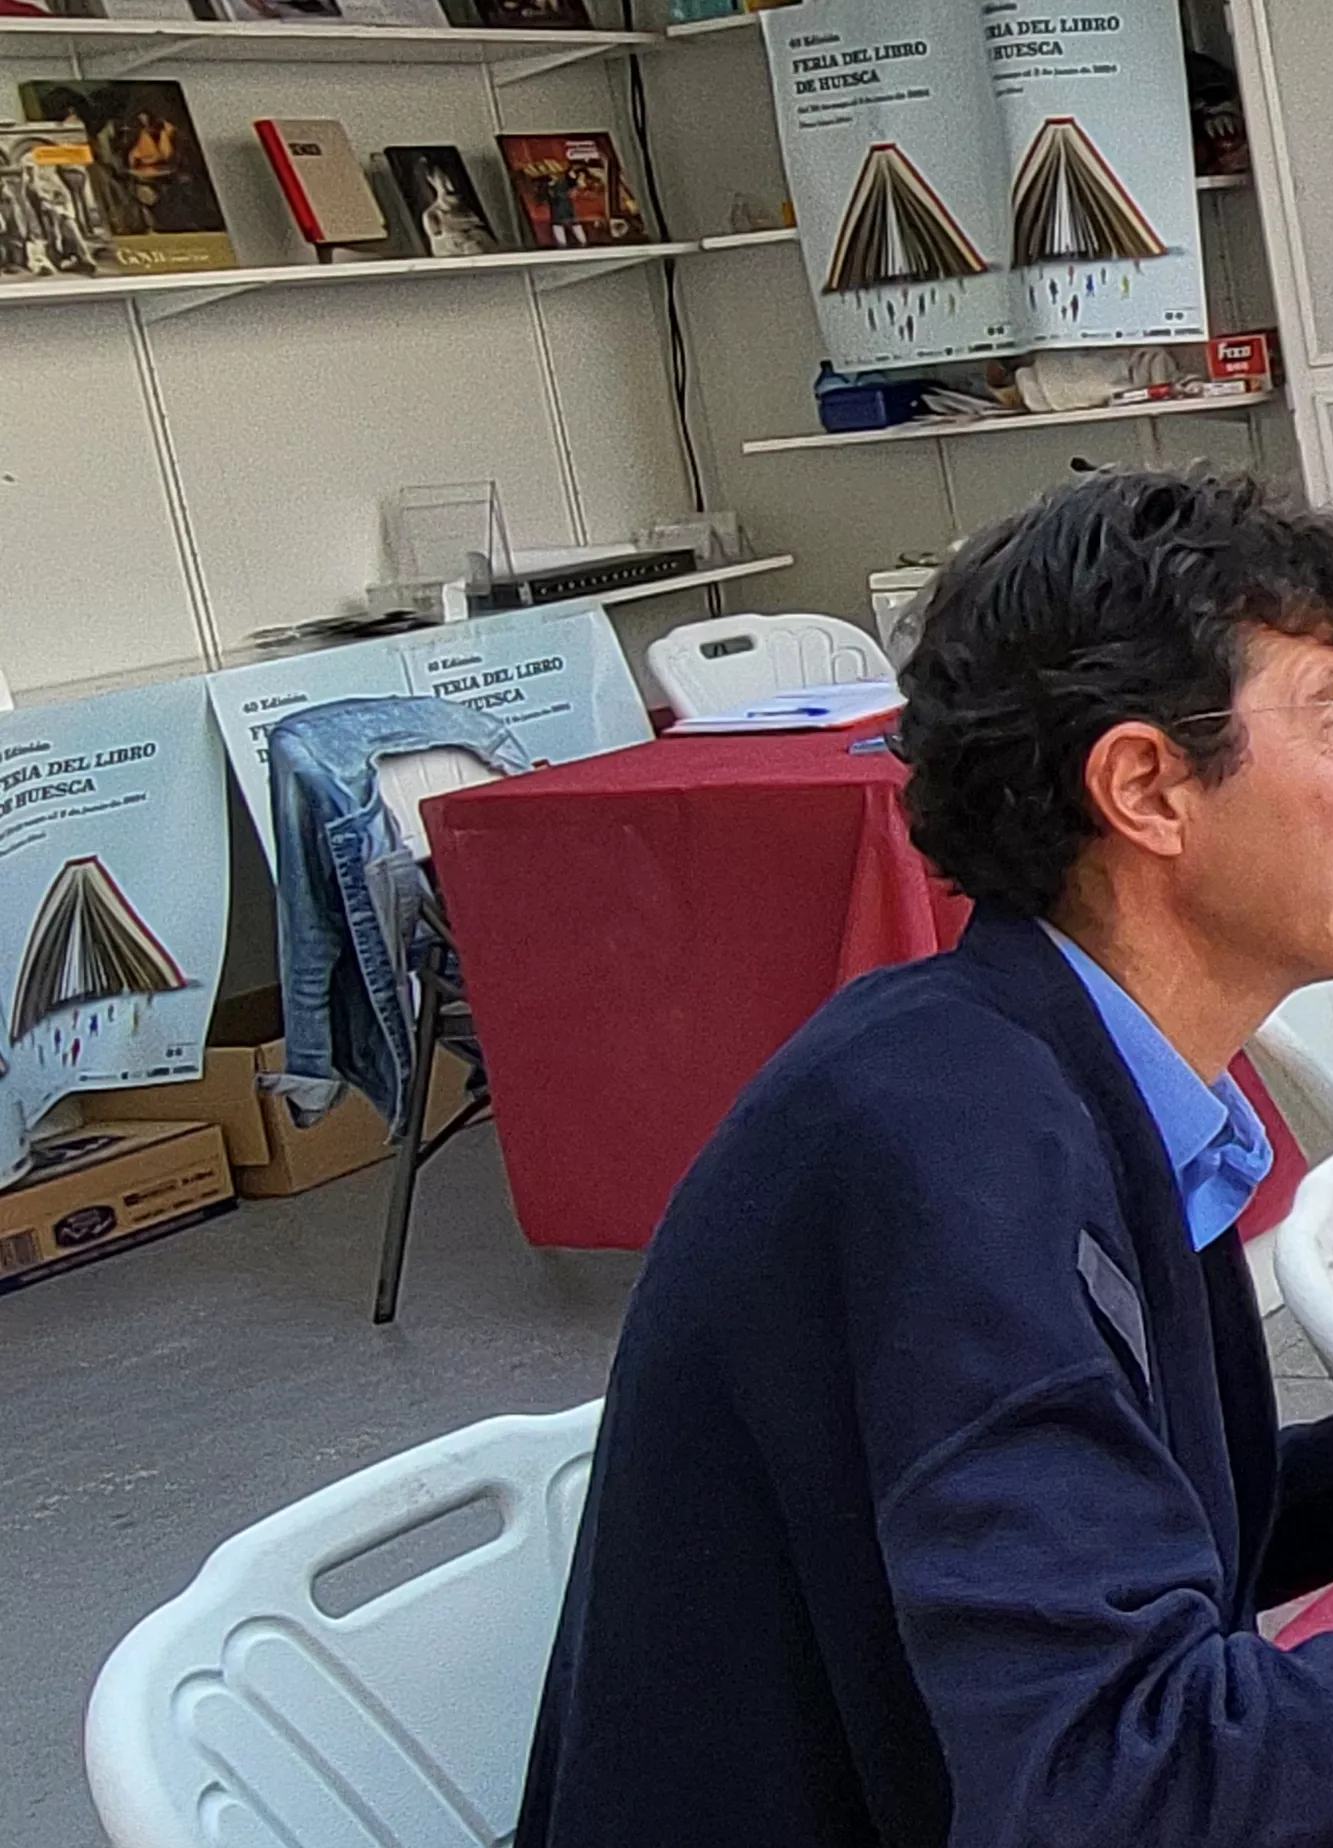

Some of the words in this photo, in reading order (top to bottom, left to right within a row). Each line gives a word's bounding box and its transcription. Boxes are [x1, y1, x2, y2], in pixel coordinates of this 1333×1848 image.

[1017, 19, 1056, 36] DEL
[1060, 16, 1120, 32] LIBRO
[842, 48, 872, 65] DEL
[874, 41, 928, 60] LIBRO
[993, 41, 1063, 60] HUESCA
[795, 78, 816, 94] DE
[819, 69, 880, 90] HUESCA
[482, 668, 514, 687] DEL
[516, 656, 564, 679] LIBRO
[0, 764, 42, 793] ERIA
[46, 756, 91, 777] DEL
[94, 743, 156, 768] LIBRO
[15, 778, 96, 808] HUESCA
